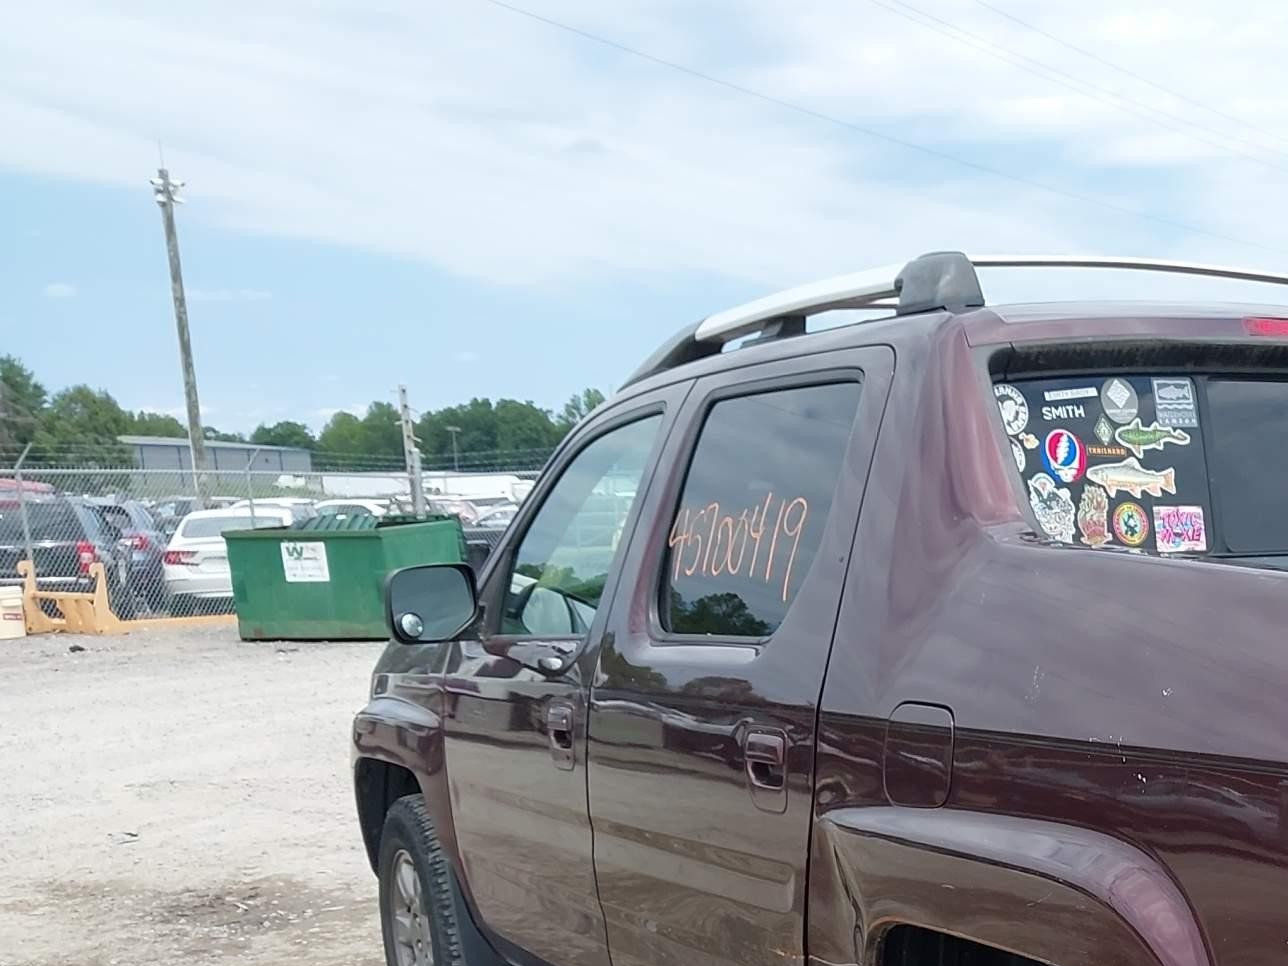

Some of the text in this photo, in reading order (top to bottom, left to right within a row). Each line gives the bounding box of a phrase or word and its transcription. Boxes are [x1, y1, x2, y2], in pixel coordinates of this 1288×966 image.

[1042, 404, 1085, 420] SMITH
[1160, 510, 1202, 529] TOXIC
[669, 492, 807, 602] 45700419
